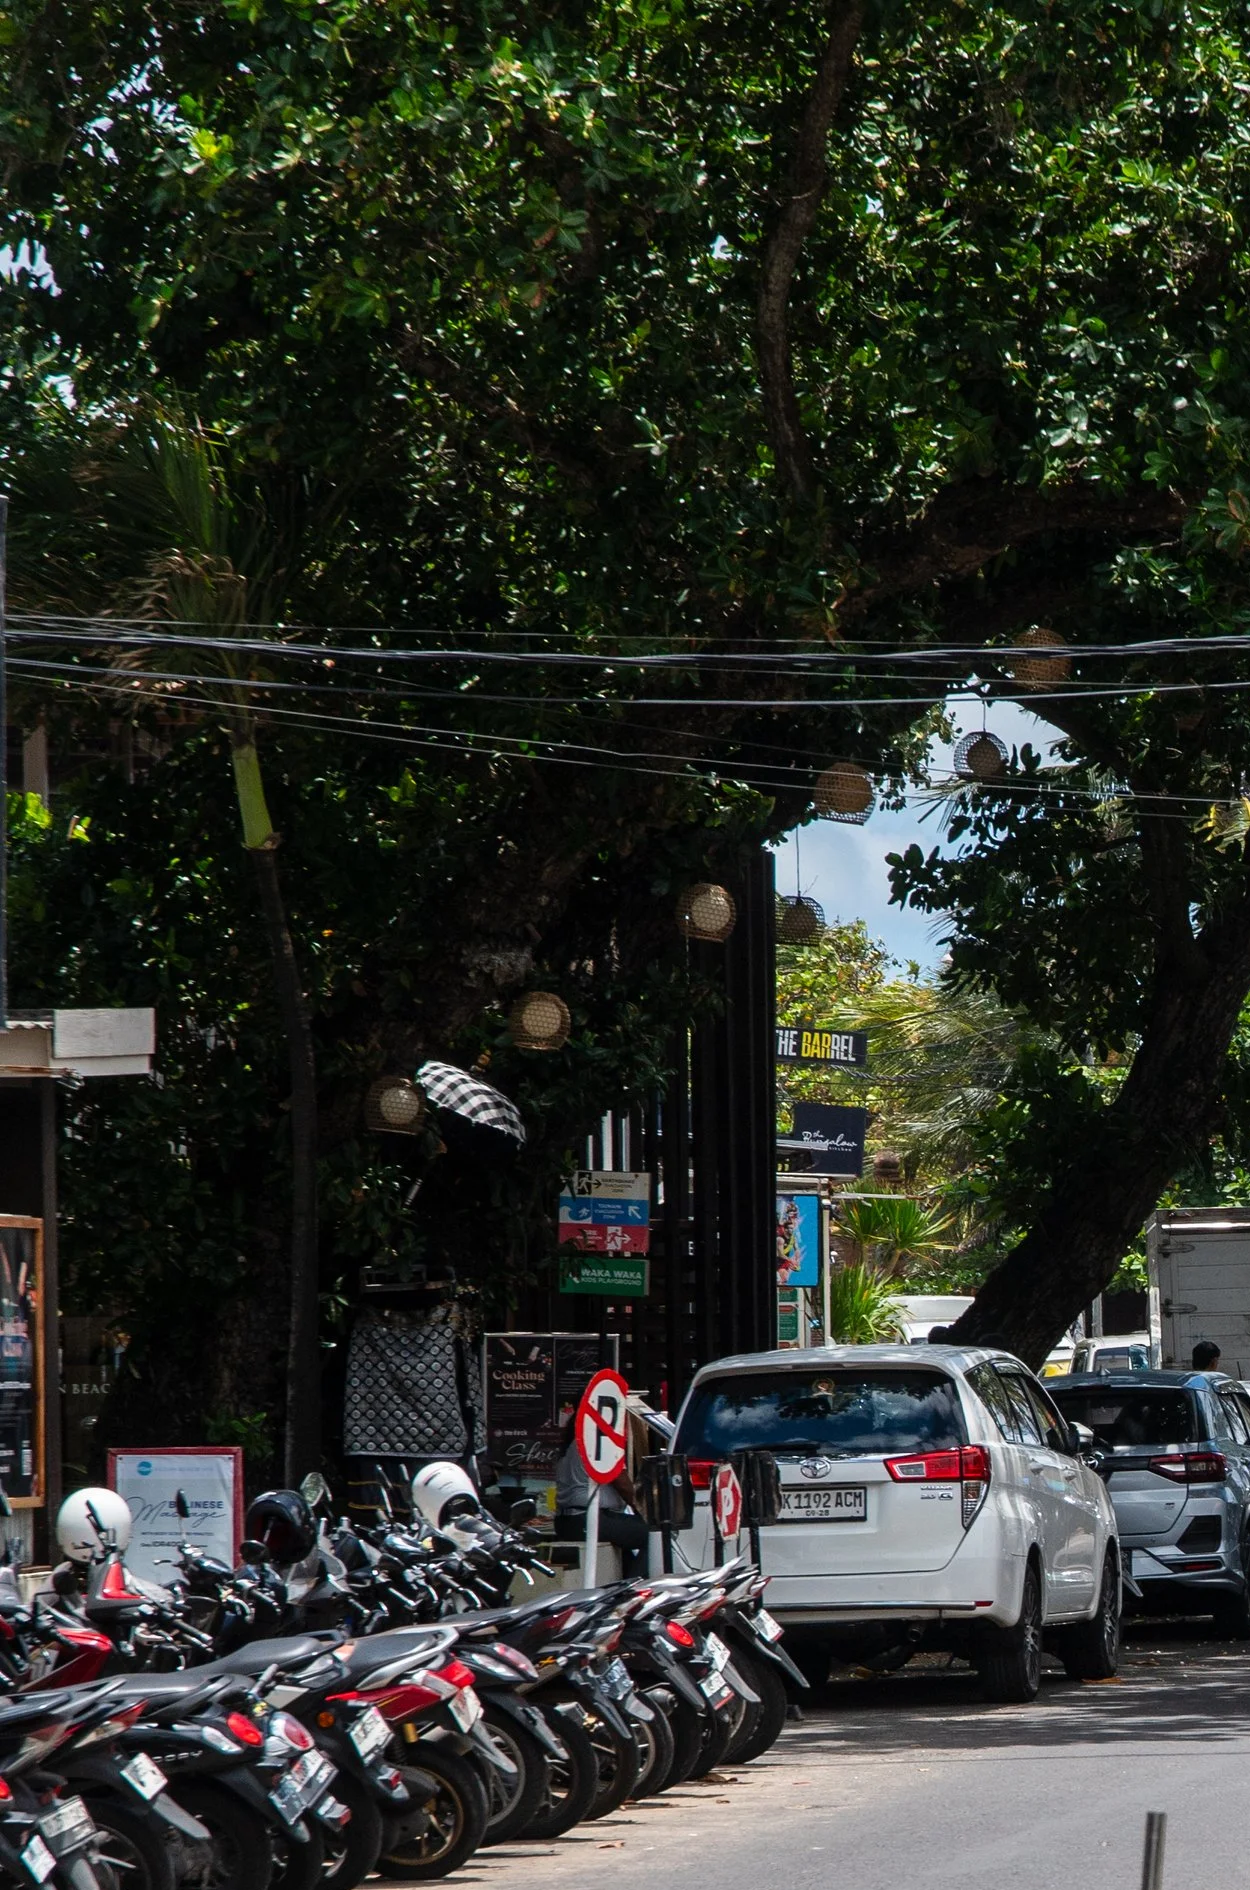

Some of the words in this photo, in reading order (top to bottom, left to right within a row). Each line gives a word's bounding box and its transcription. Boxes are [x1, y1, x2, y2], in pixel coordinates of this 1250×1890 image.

[775, 1029, 798, 1056] HE
[801, 1031, 856, 1061] BARREL
[581, 1268, 611, 1278] WAKA
[613, 1269, 642, 1280] WAKA
[599, 1278, 642, 1286] PLAYGROUND
[492, 1369, 545, 1382] Cooking
[501, 1380, 537, 1391] Class
[594, 1395, 618, 1462] P
[169, 1500, 224, 1509] BINESE
[795, 1493, 831, 1509] 1192
[834, 1491, 864, 1508] ACM
[126, 1496, 226, 1528] Masage
